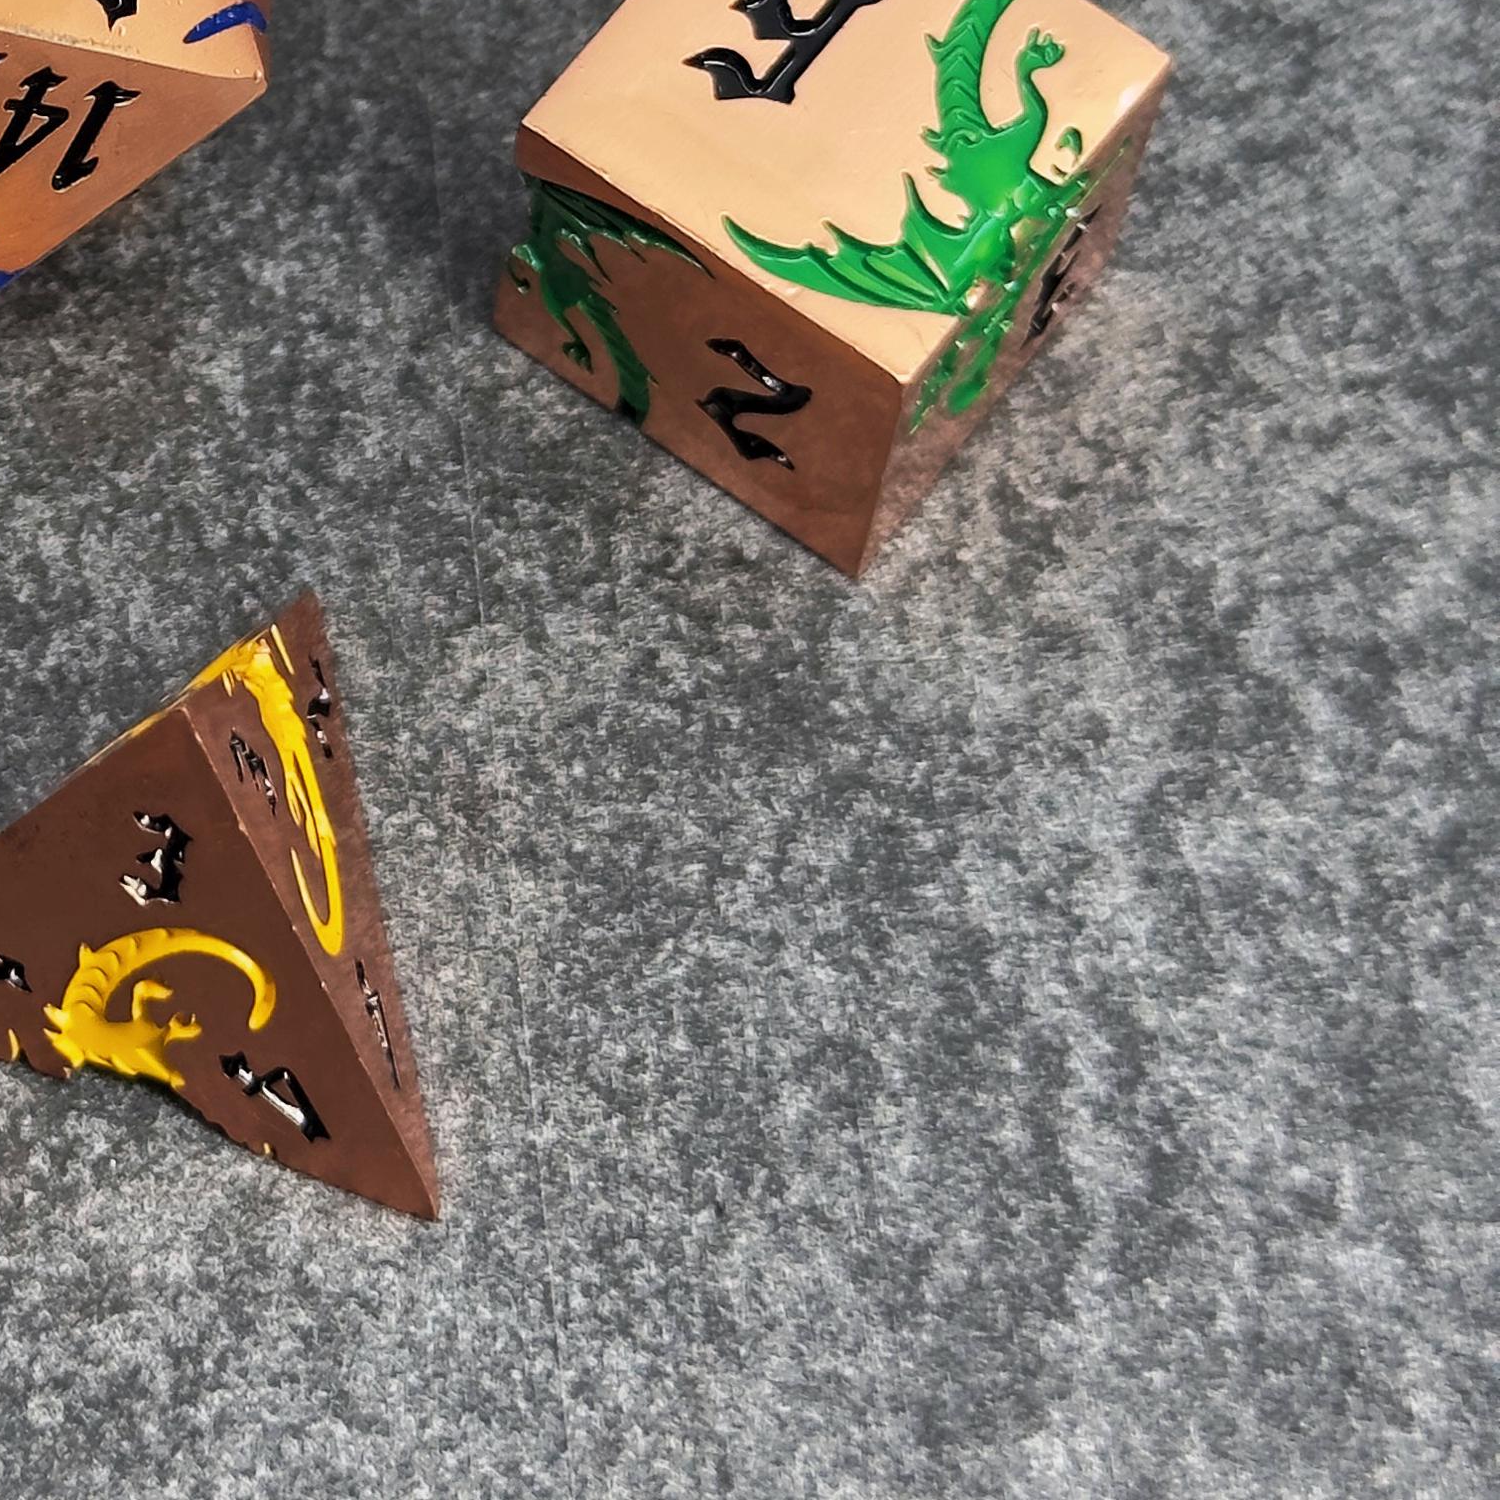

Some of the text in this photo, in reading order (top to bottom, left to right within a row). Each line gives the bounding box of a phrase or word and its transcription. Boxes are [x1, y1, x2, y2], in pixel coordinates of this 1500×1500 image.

[695, 337, 813, 470] 2
[119, 810, 194, 906] 3
[219, 1050, 331, 1143] 4
